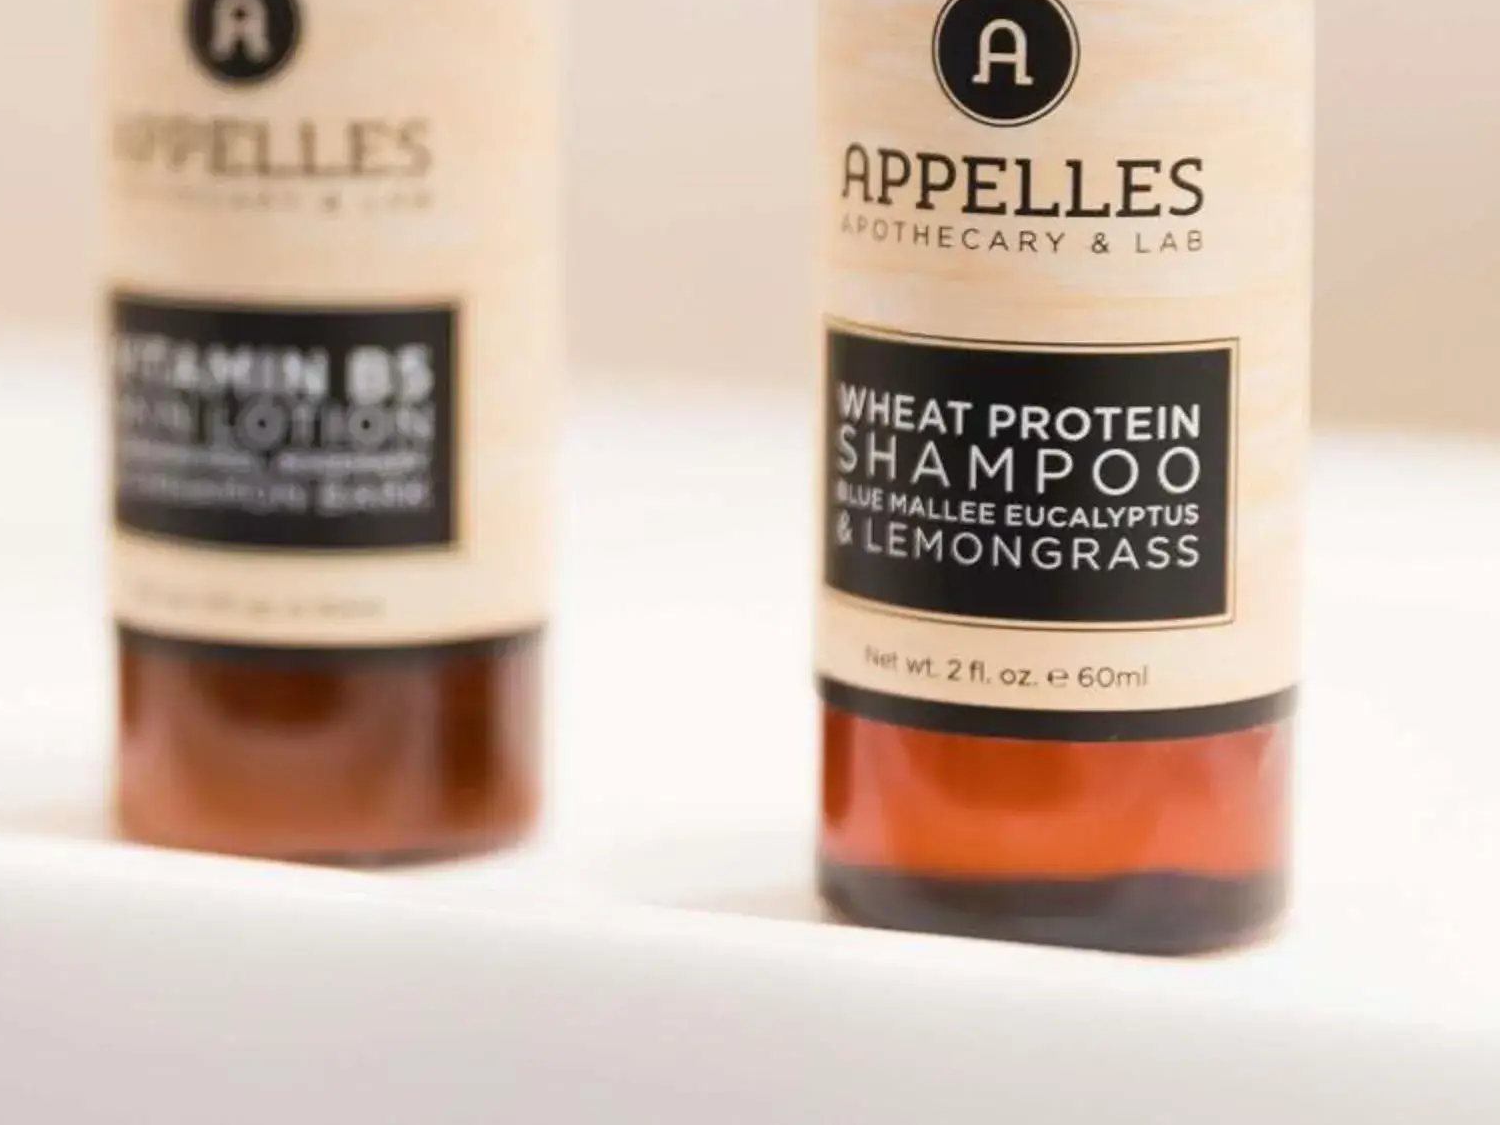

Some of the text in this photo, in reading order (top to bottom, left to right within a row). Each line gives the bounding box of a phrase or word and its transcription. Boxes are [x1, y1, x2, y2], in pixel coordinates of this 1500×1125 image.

[971, 17, 1034, 86] A
[841, 142, 1205, 219] APPELLES
[840, 210, 1205, 255] APOTHECARY & LAB
[835, 381, 1201, 443] WHEAT PROTEIN
[836, 425, 1201, 497] SHAMPOO
[836, 509, 1200, 572] & LEMONGRASS
[891, 491, 997, 525] MALLEE
[1006, 503, 1200, 531] EUCALYPTUS
[864, 644, 899, 672] Net
[947, 659, 962, 682] 2
[969, 659, 992, 684] fl.
[999, 668, 1039, 687] oz.
[1076, 665, 1149, 689] 60ml
